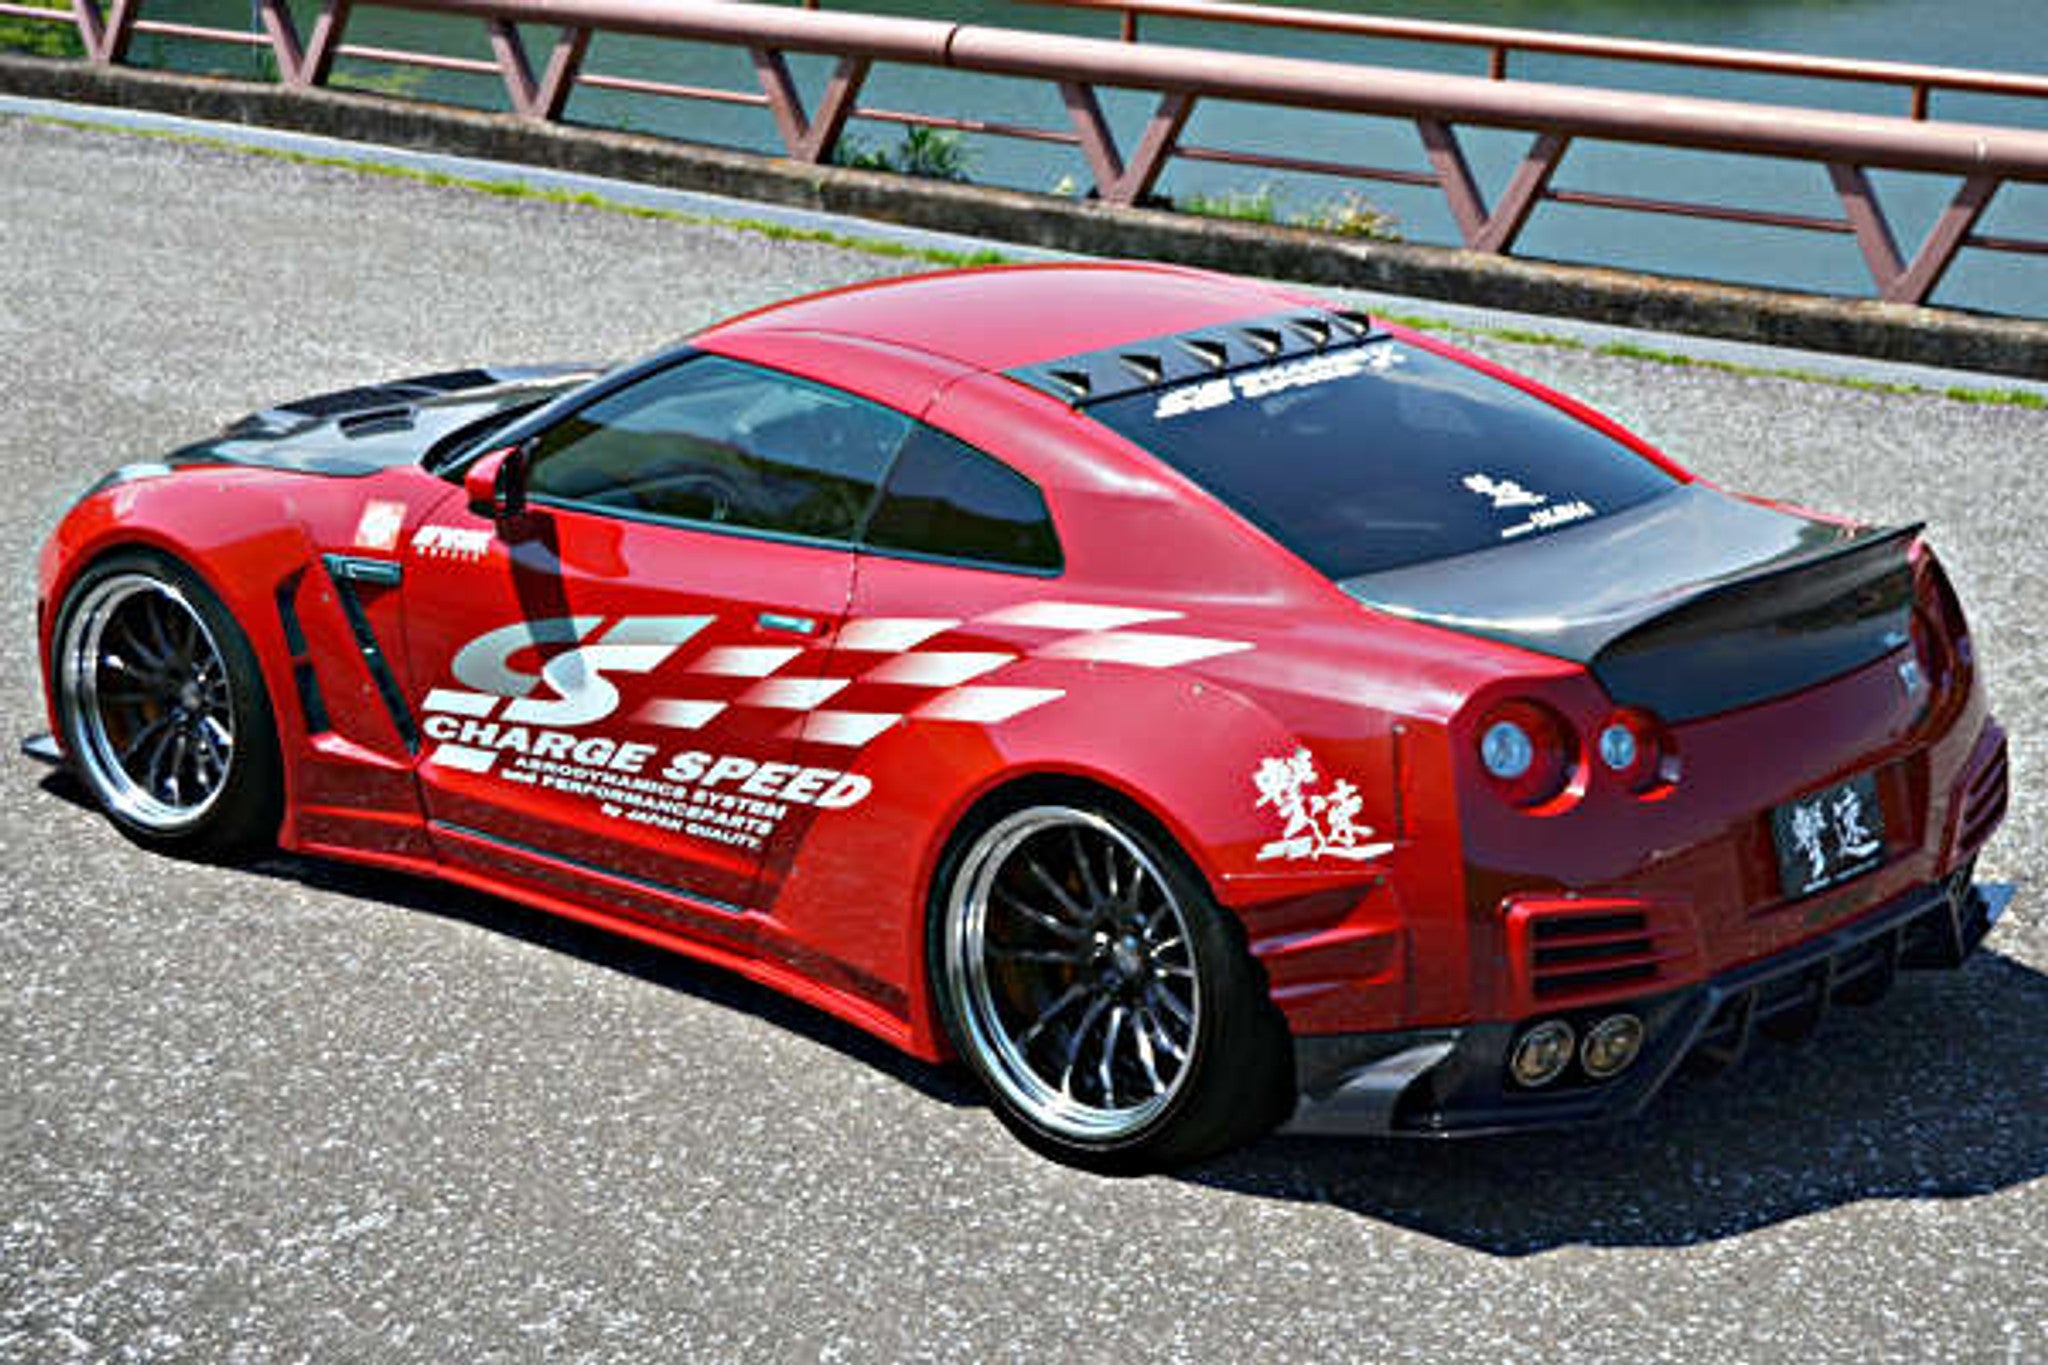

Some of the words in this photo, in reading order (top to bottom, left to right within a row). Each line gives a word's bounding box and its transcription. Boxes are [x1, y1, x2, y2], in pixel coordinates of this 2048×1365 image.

[423, 715, 658, 773] CHARGE
[661, 751, 873, 809] SPEED
[625, 809, 683, 832] JAPAN
[692, 789, 787, 821] SYSTEM
